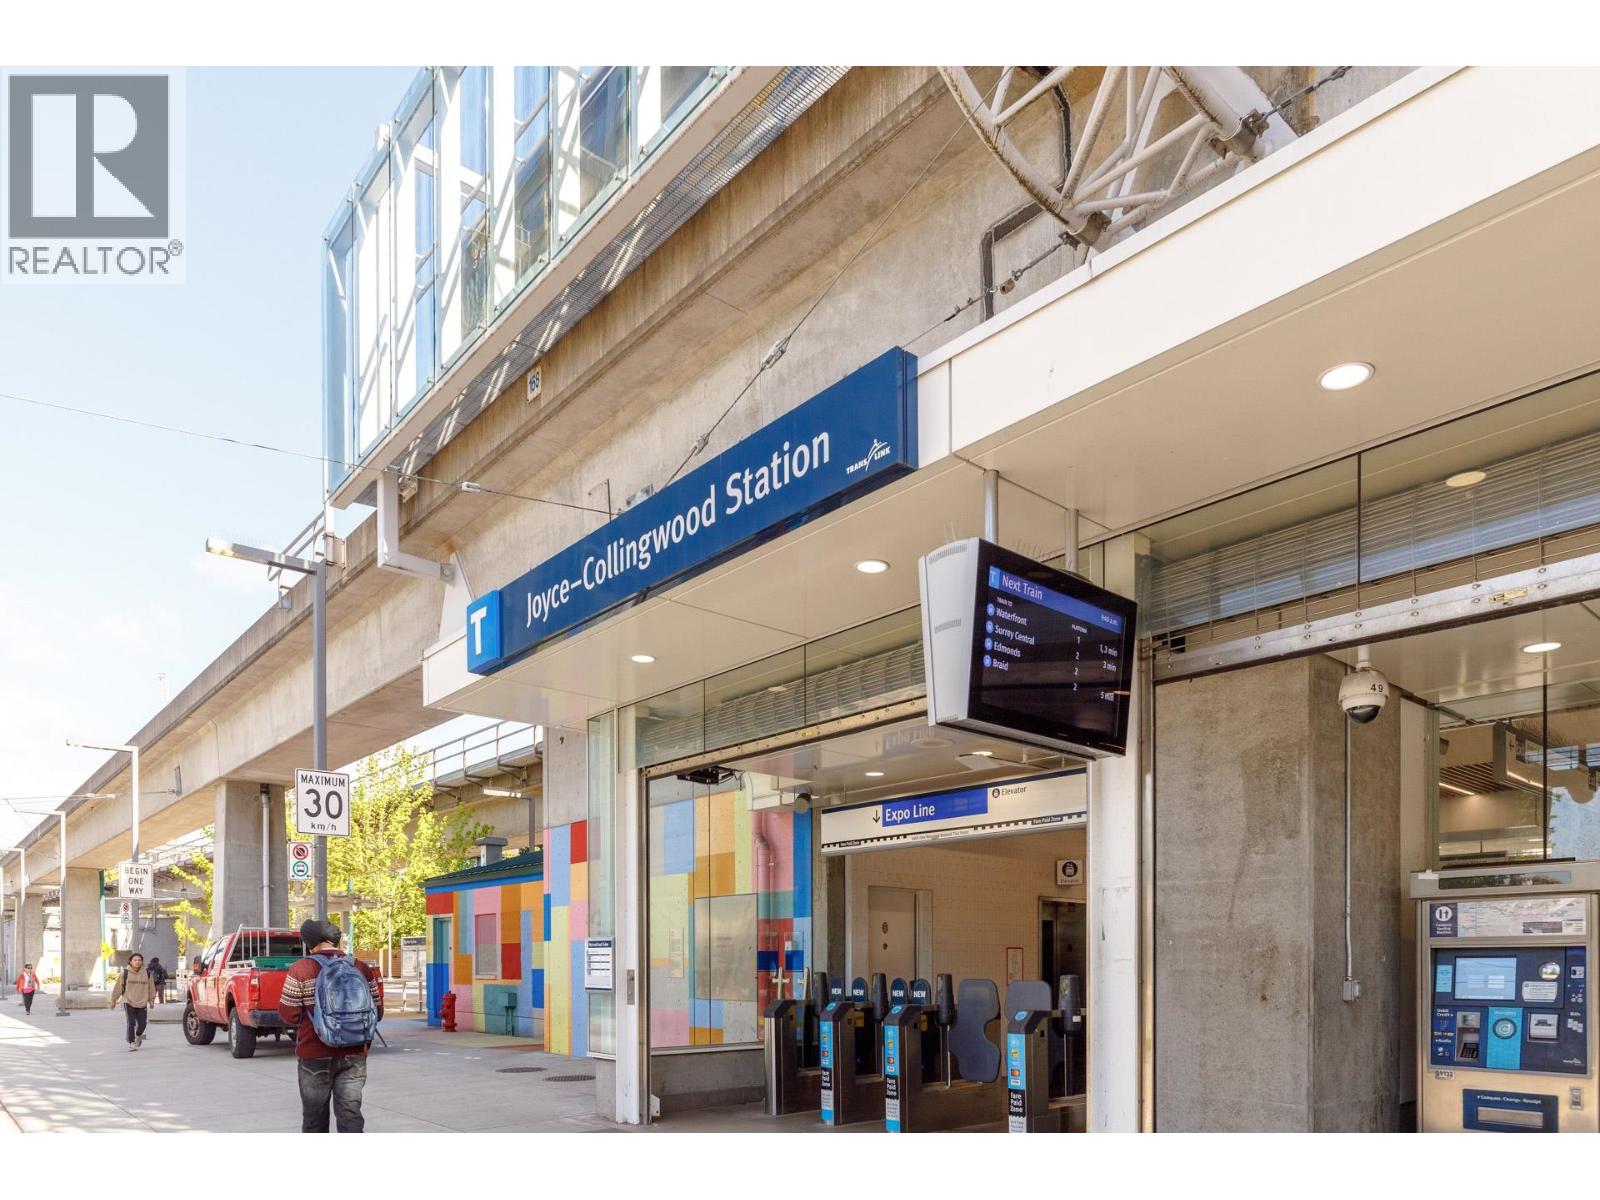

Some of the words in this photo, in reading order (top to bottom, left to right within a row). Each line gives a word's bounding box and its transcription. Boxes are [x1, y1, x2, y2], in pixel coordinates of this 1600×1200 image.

[725, 431, 830, 515] Station
[1002, 575, 1021, 592] Next
[1023, 582, 1043, 600] Train
[996, 607, 1027, 626] Waterfront
[470, 606, 488, 656] T
[995, 624, 1014, 640] Surrey
[1014, 631, 1035, 645] Central
[993, 641, 1021, 658] Edmonds
[992, 659, 1009, 671] Braid
[1370, 683, 1384, 693] 49
[301, 774, 346, 788] MAXIMUM
[1001, 785, 1027, 796] Elevator
[304, 788, 343, 819] 30
[885, 807, 911, 824] Expo
[913, 803, 936, 818] Line
[311, 822, 337, 832] km/h
[124, 866, 149, 875] BEGIN
[128, 877, 144, 886] ONE
[128, 887, 144, 896] WAY
[831, 987, 842, 995] NEW
[852, 988, 865, 996] NEW
[913, 990, 927, 998] NEW
